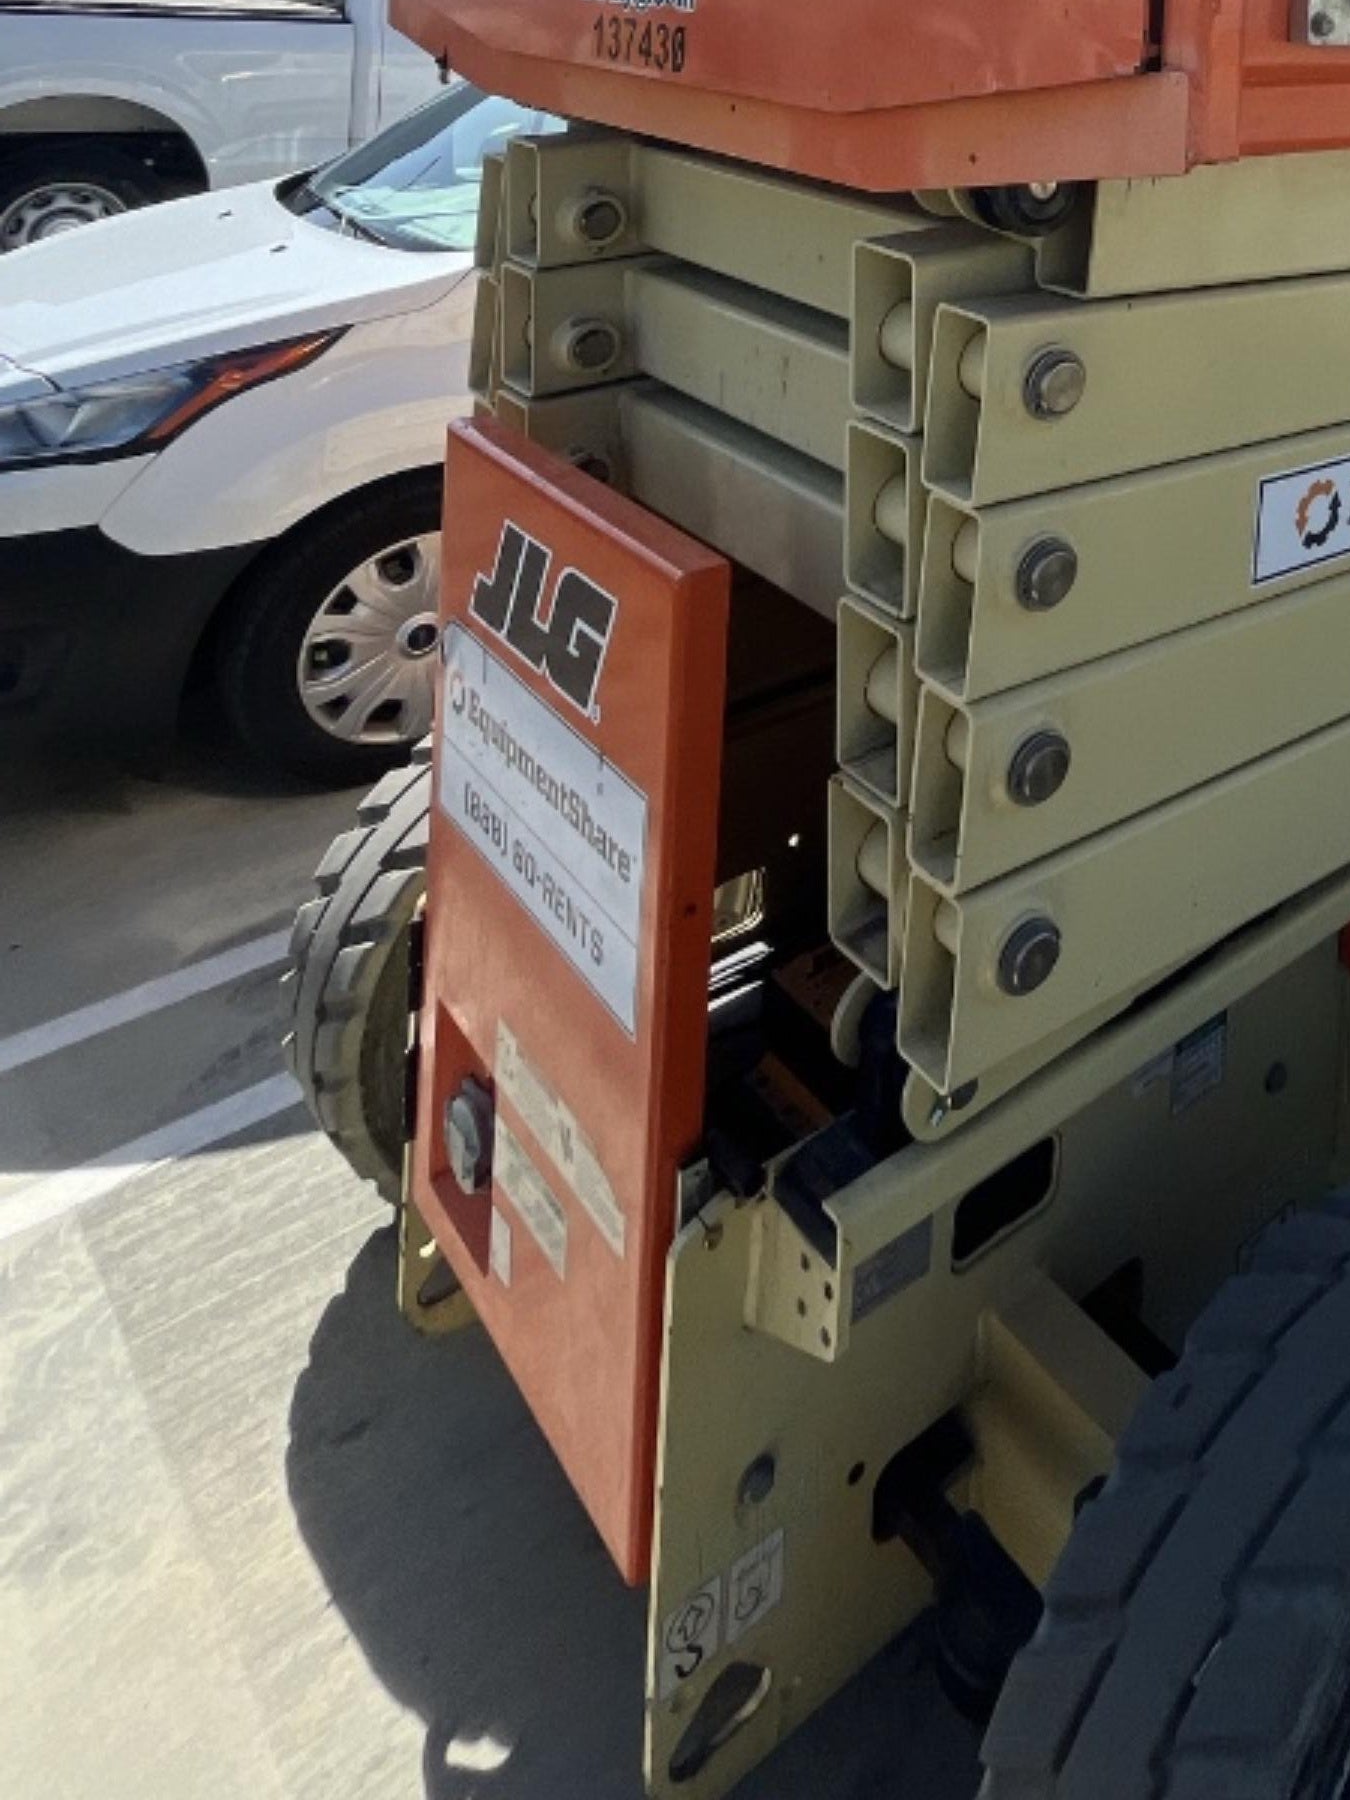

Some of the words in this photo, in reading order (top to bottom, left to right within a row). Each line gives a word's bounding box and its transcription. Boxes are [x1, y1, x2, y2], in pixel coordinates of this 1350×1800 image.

[592, 15, 687, 73] 137430
[468, 518, 620, 712] JLG
[466, 685, 632, 884] EquipmentShare
